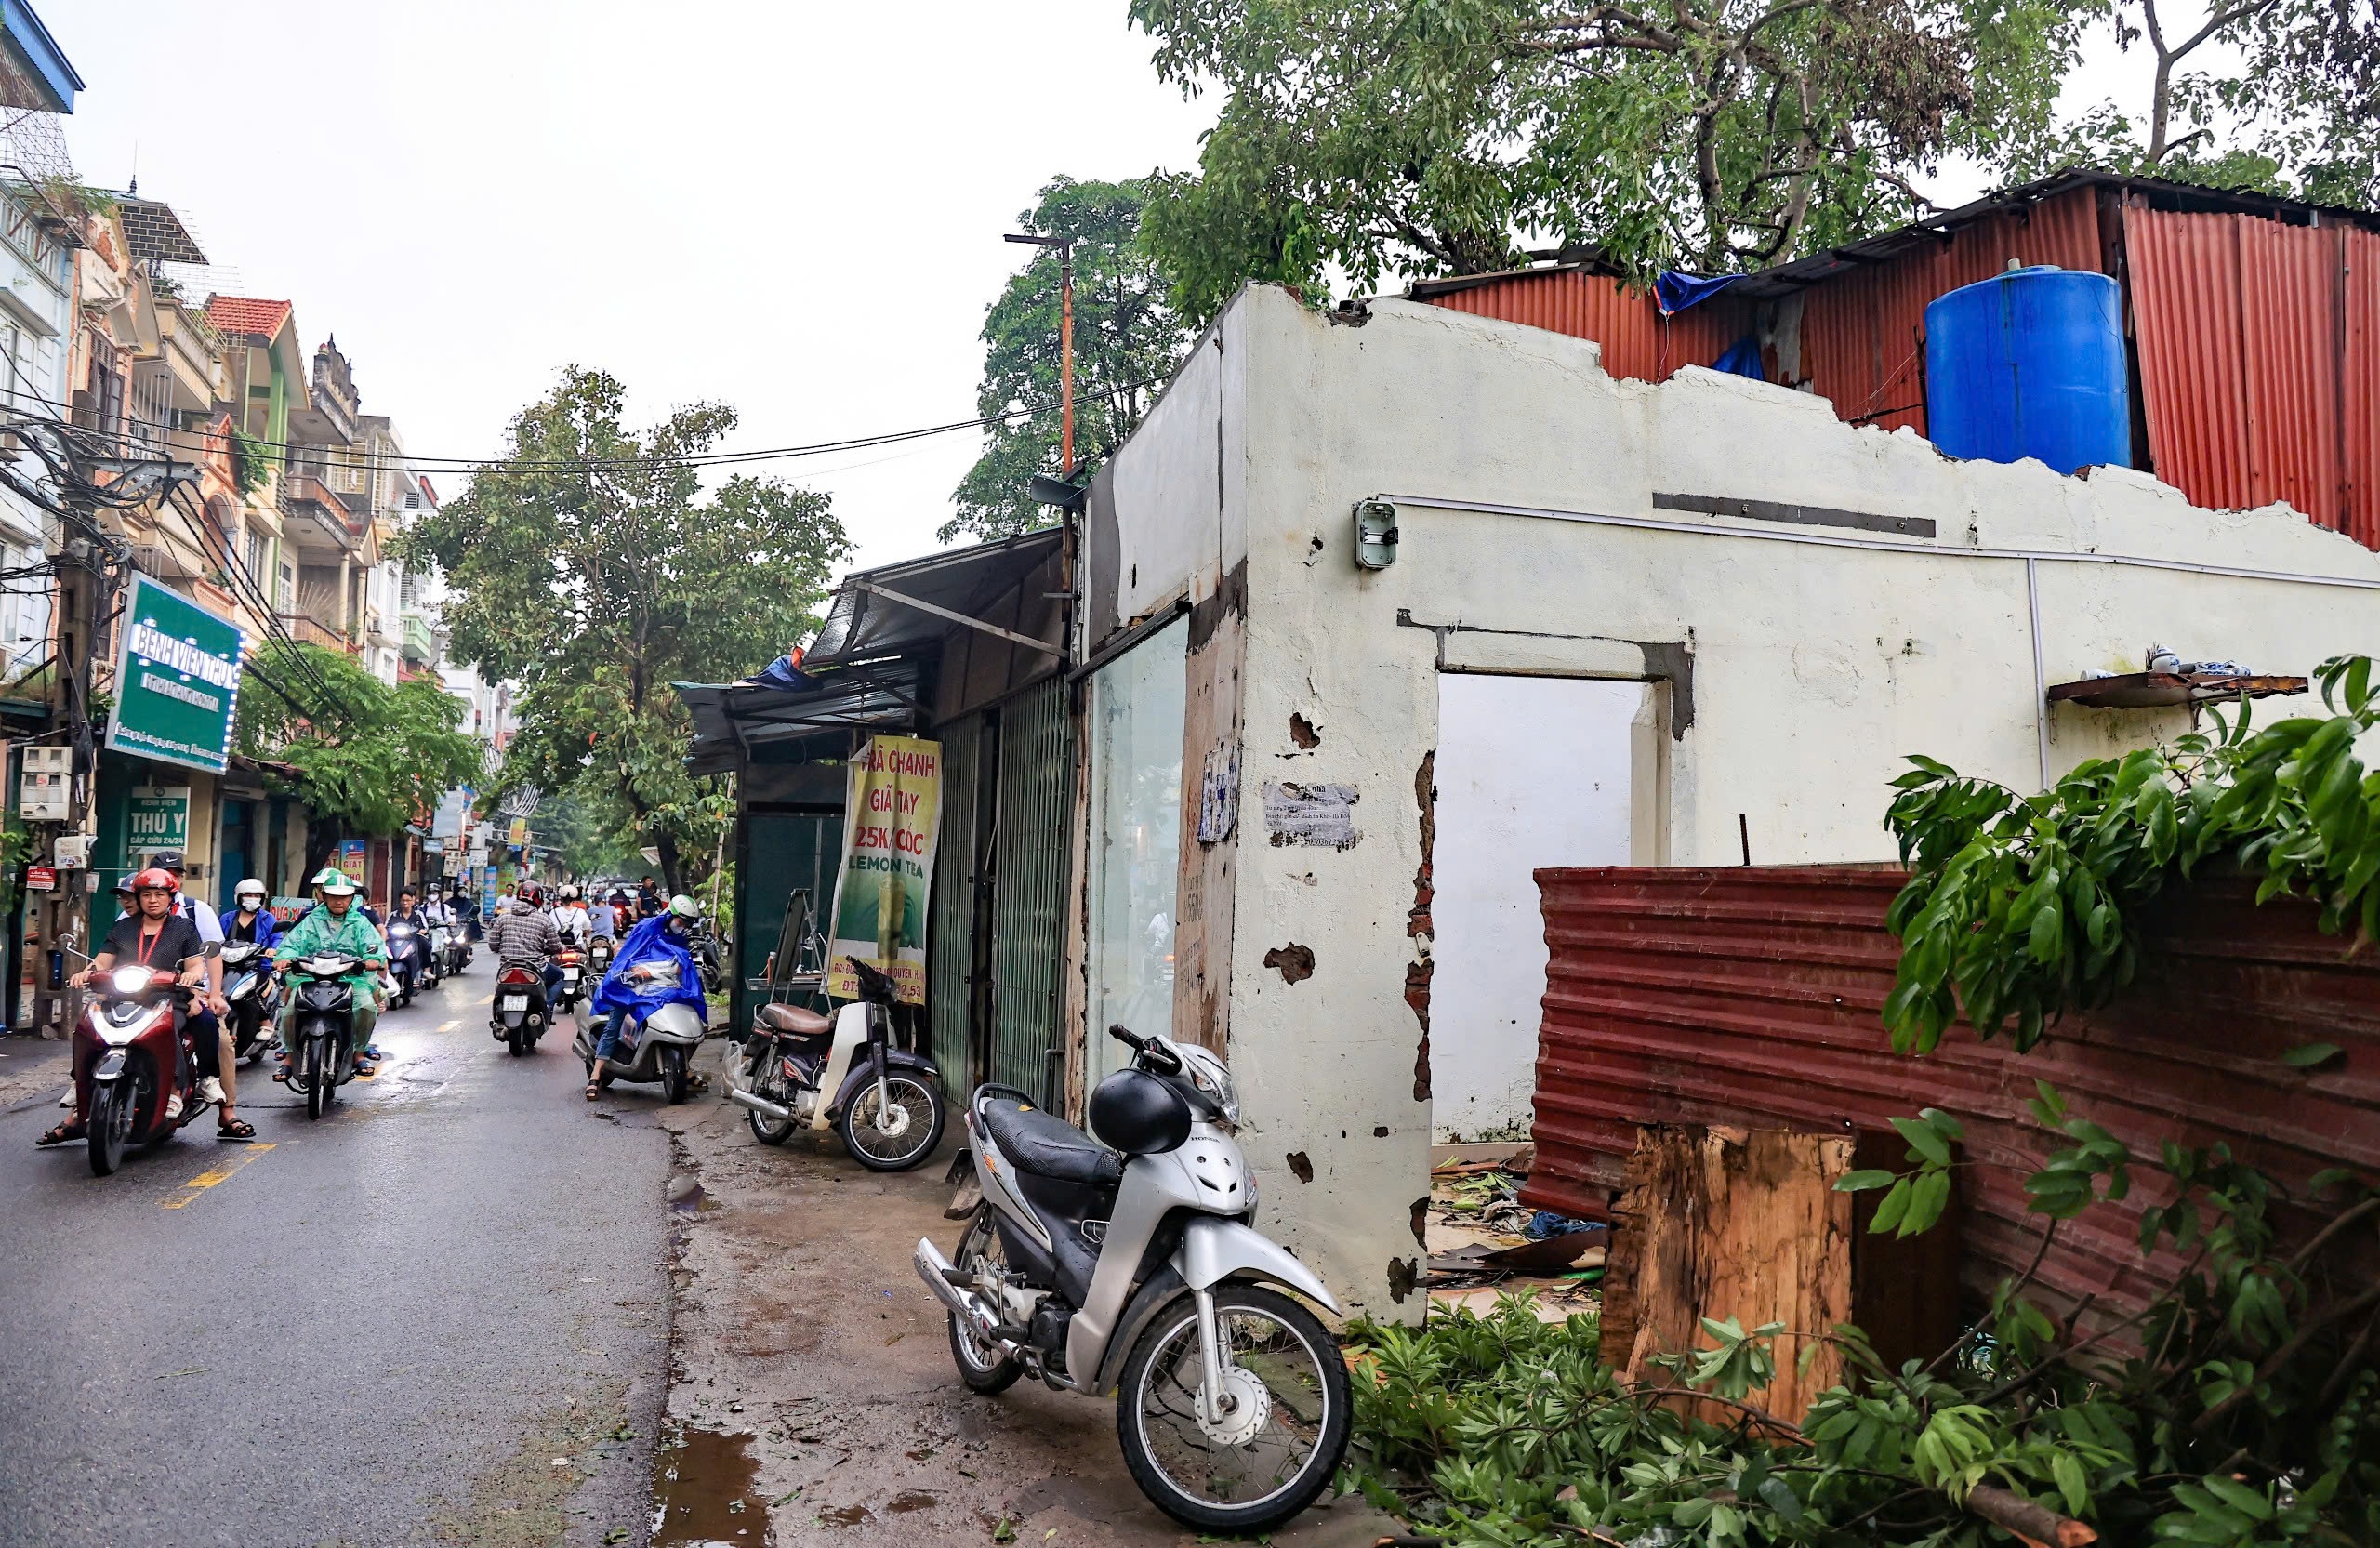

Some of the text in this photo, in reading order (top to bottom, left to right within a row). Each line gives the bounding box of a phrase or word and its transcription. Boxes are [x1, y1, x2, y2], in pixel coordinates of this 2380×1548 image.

[888, 750, 935, 778] CHANH
[869, 784, 919, 815] GIÃ TAY
[131, 808, 185, 833] THÚ Y
[848, 855, 923, 879] LEMON TEA
[841, 980, 858, 993] ĐT:
